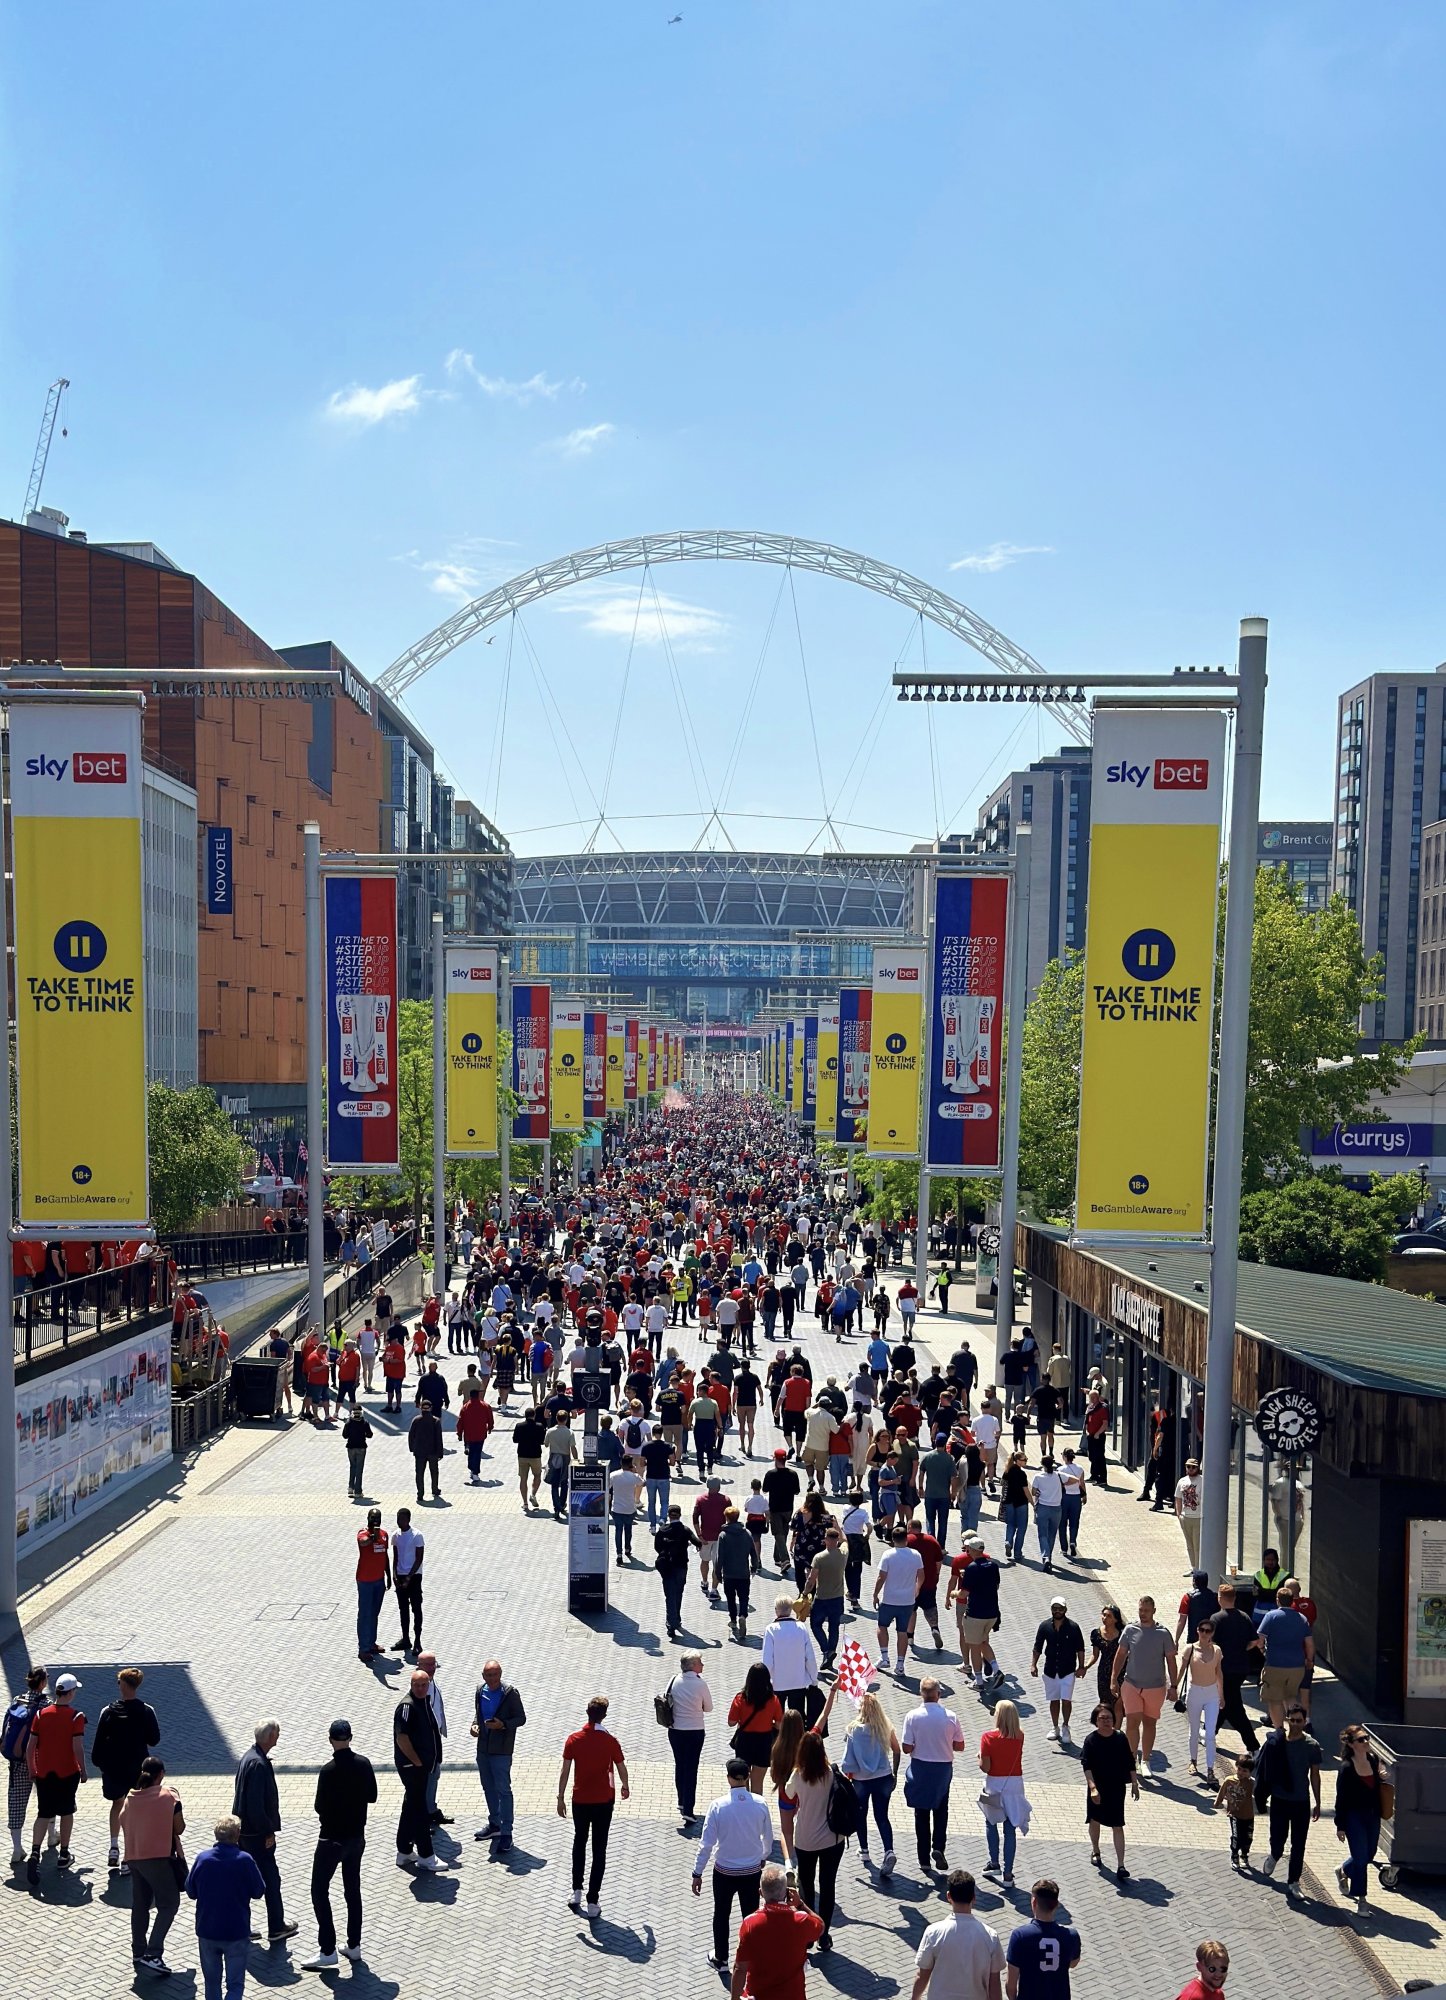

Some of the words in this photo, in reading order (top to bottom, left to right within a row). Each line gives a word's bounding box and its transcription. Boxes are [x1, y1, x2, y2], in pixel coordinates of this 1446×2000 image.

[345, 666, 372, 716] NOVOTEL
[26, 754, 69, 781] sky
[79, 755, 121, 777] bet
[1107, 761, 1150, 788] sky
[1160, 762, 1202, 783] bet
[1282, 835, 1312, 845] Brent
[1314, 834, 1333, 845] Civi
[214, 833, 226, 902] NOVOTEL
[335, 936, 351, 944] IT'S
[352, 936, 374, 944] TIME
[376, 936, 389, 944] TO
[943, 936, 958, 945] IT'S
[960, 936, 983, 945] TIME
[985, 937, 998, 945] TO
[601, 952, 677, 967] WEMBLEY
[680, 953, 771, 969] CONNECTED
[776, 954, 794, 968] BY
[800, 955, 818, 969] EE
[452, 968, 469, 979] sky
[472, 969, 490, 978] bet
[879, 968, 896, 979] sky
[899, 969, 917, 978] bet
[27, 978, 79, 994] TAKE
[84, 978, 134, 995] TIME
[1093, 986, 1145, 1003] TAKE
[1150, 987, 1201, 1004] TIME
[33, 996, 60, 1012] TO
[65, 996, 132, 1012] THINK
[945, 1001, 955, 1016] sky
[980, 1003, 989, 1016] sky
[1098, 1004, 1125, 1021] TO
[1131, 1005, 1198, 1021] THINK
[343, 1018, 351, 1032] bet
[344, 1043, 352, 1057] sky
[946, 1044, 955, 1058] sky
[980, 1045, 988, 1058] sky
[896, 1055, 916, 1063] TIME
[980, 1060, 988, 1075] bet
[221, 1095, 251, 1114] NOVOTEL
[343, 1103, 356, 1111] sky
[358, 1103, 371, 1111] bet
[944, 1104, 957, 1112] sky
[1341, 1133, 1405, 1152] currys
[74, 1171, 90, 1180] 18+
[1131, 1181, 1147, 1190] 18+
[1111, 1283, 1127, 1324] BLACK
[1126, 1291, 1141, 1331] SHEEP
[1140, 1298, 1163, 1344] COFFEE
[1262, 1397, 1285, 1430] BLACK
[1285, 1394, 1317, 1415] SHEEP
[1277, 1426, 1318, 1451] COFFEE
[1039, 1938, 1060, 1971] 3
